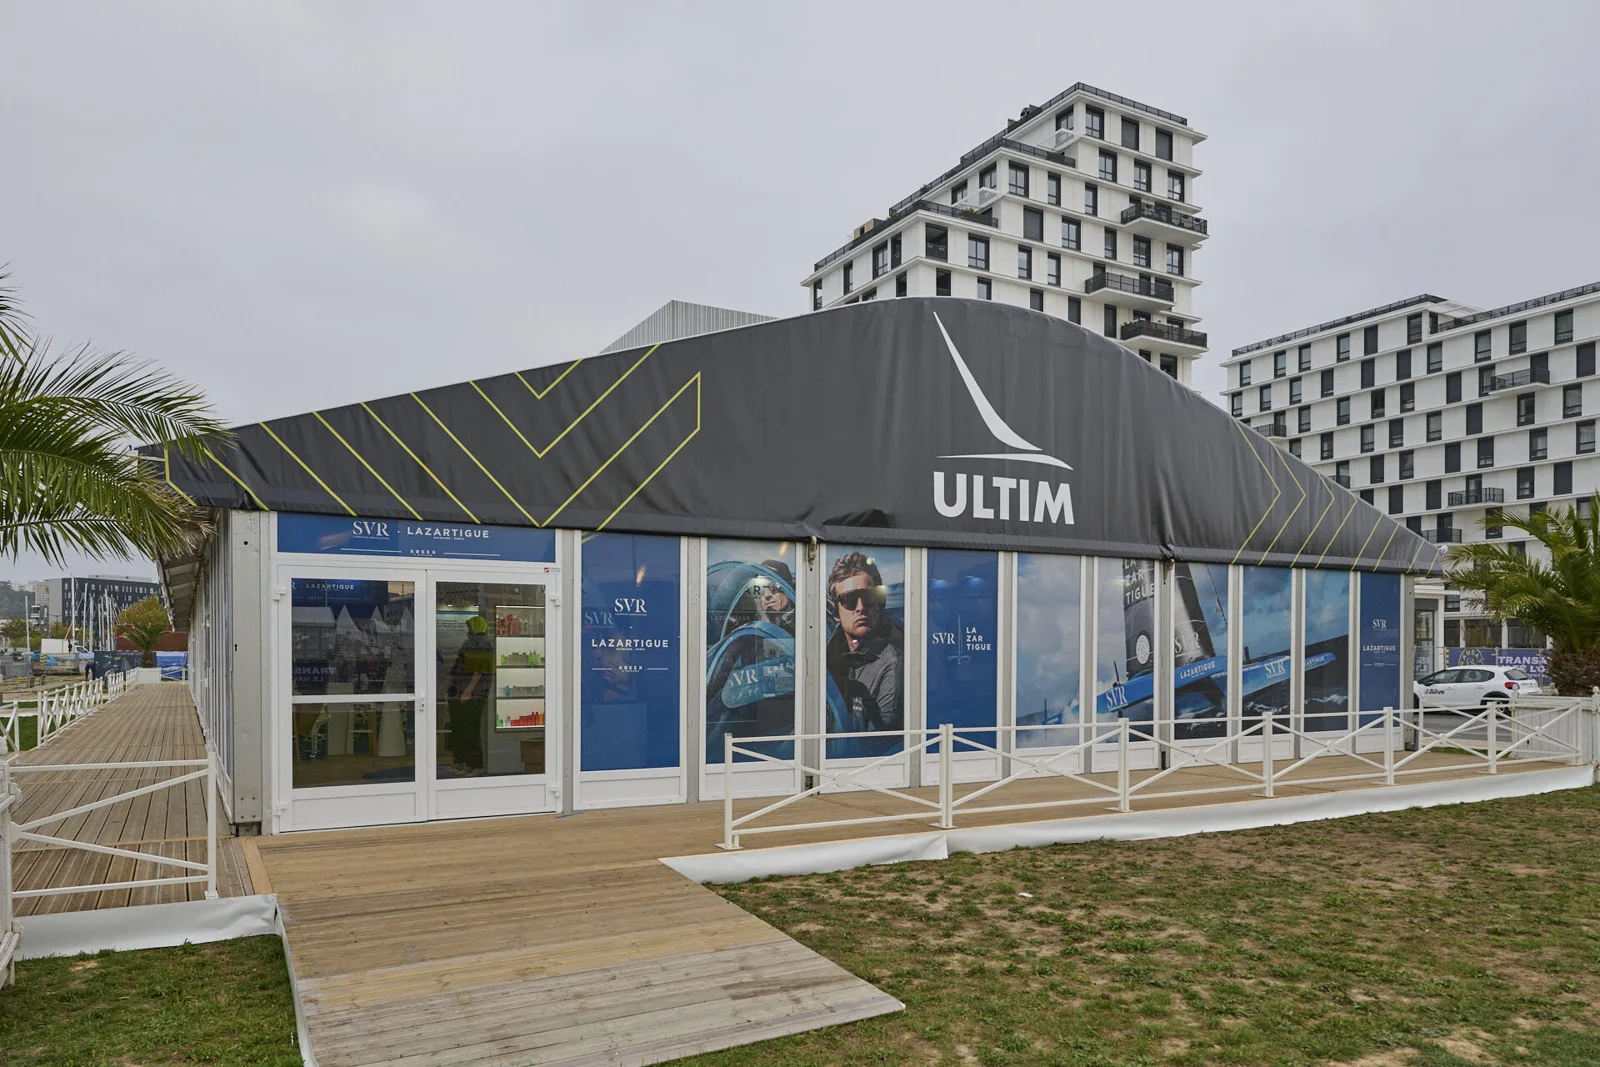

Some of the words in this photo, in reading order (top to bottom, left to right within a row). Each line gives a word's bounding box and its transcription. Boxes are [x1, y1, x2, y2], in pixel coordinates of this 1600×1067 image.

[933, 471, 1075, 525] ULTIM
[352, 520, 389, 537] SVR
[407, 526, 489, 539] LAZARTIGUE
[1125, 582, 1154, 604] TIGUE
[614, 598, 647, 613] SVR
[584, 611, 614, 625] SVR
[1372, 619, 1387, 629] SVR
[591, 639, 669, 648] LAZARTIGUE
[932, 632, 955, 645] SVR
[966, 643, 991, 651] TIGUE
[1264, 660, 1286, 676] SVR
[1498, 656, 1549, 665] TRANSA
[1180, 661, 1216, 679] LAZARTIGUE
[1106, 686, 1128, 709] SVR
